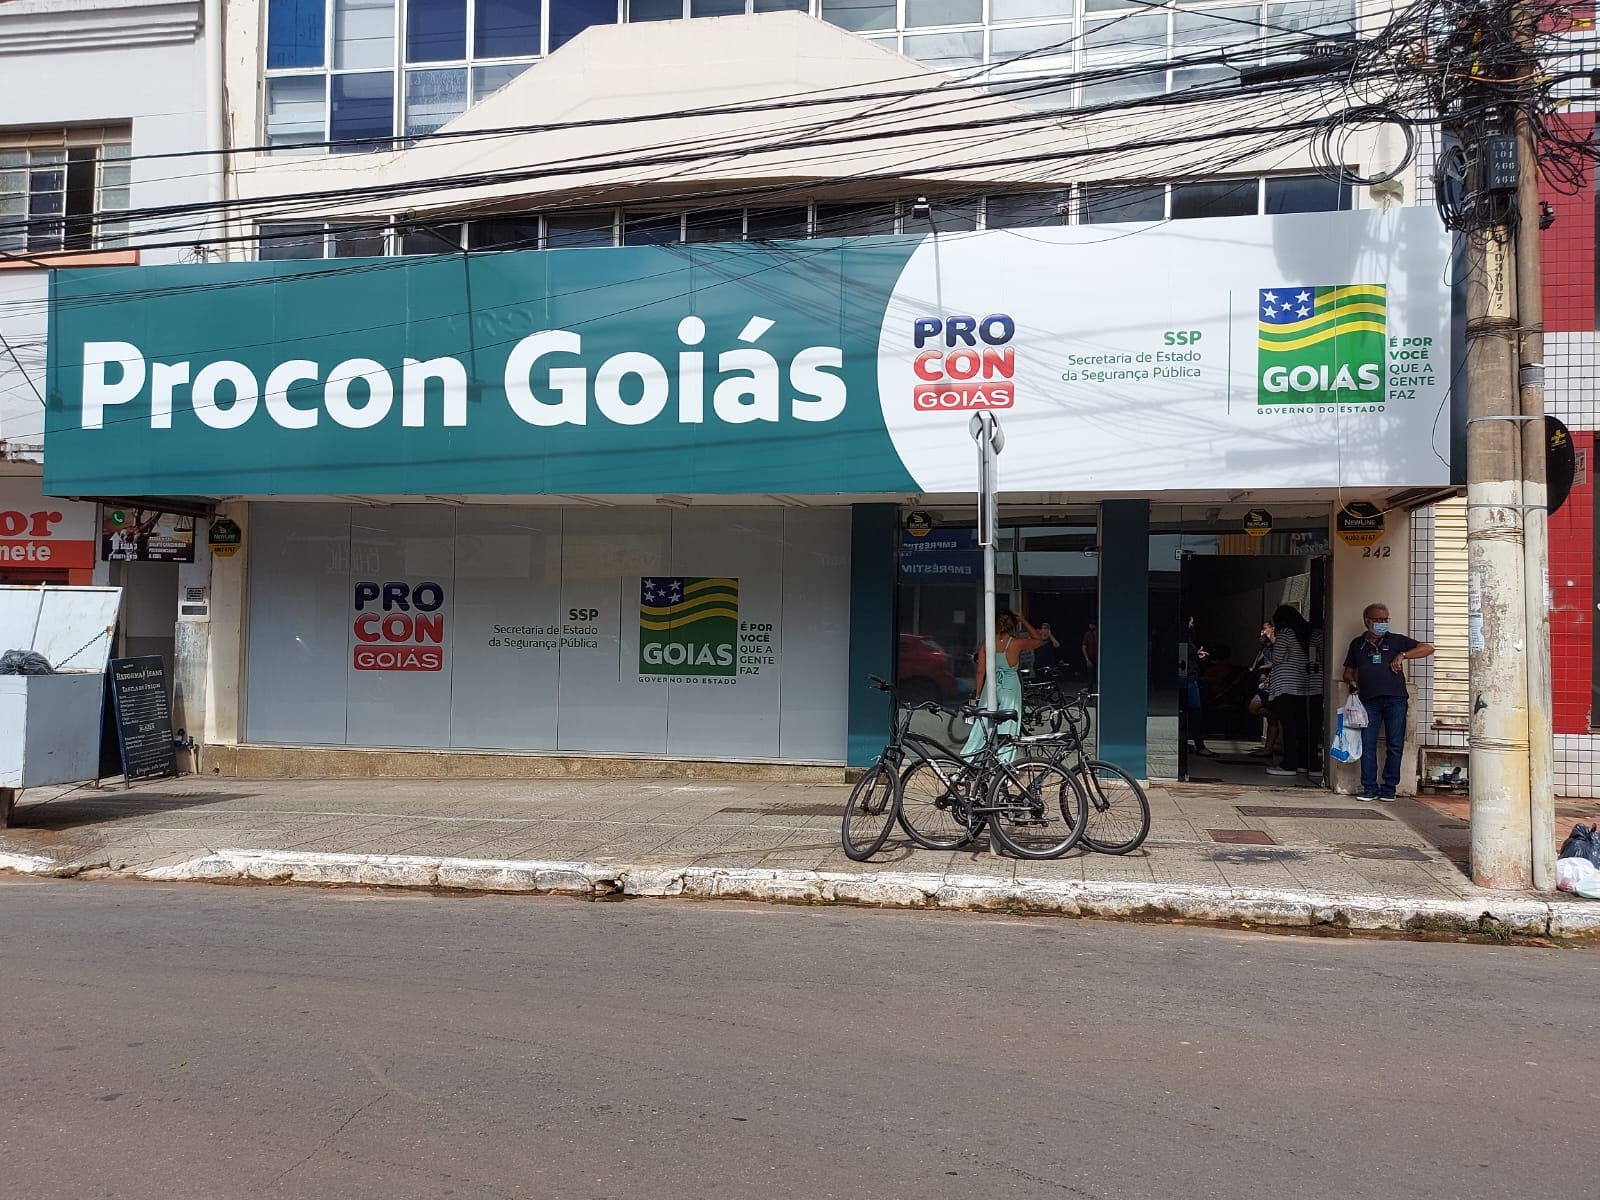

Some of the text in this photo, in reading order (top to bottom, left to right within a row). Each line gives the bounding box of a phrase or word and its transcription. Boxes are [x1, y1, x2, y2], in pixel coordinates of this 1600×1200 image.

[914, 314, 1015, 348] PRO
[1164, 331, 1201, 346] SSP
[1389, 336, 1432, 347] É POR
[1068, 351, 1201, 366] Secretaria de Estado
[1389, 348, 1429, 360] VOCÊ
[913, 347, 1015, 381] CON
[1389, 363, 1433, 375] QUE A
[81, 315, 847, 429] Procon Goiás
[1062, 365, 1201, 382] da Segurança Pública
[1263, 364, 1380, 392] GOIÁS
[1389, 376, 1435, 386] GENTE
[917, 386, 1010, 408] GOIÁS
[1389, 390, 1415, 399] FAZ
[1257, 406, 1314, 415] GOVERNO
[1340, 405, 1385, 413] ESTADO
[1363, 546, 1391, 558] 242
[354, 582, 444, 611] PRO
[569, 609, 599, 621] SSP
[354, 612, 444, 643] CON
[494, 625, 598, 635] Secretaria de Estado
[740, 621, 773, 631] É POR
[488, 637, 598, 649] da Segurança Pública
[740, 633, 770, 642] VOCÊ
[643, 642, 733, 666] GOIÁS
[740, 645, 773, 654] QUE A
[357, 649, 439, 668] GOIÁS
[740, 656, 775, 665] GENTE
[740, 667, 760, 675] FAZ
[638, 676, 682, 684] GOVERNO
[702, 677, 737, 685] ESTADO
